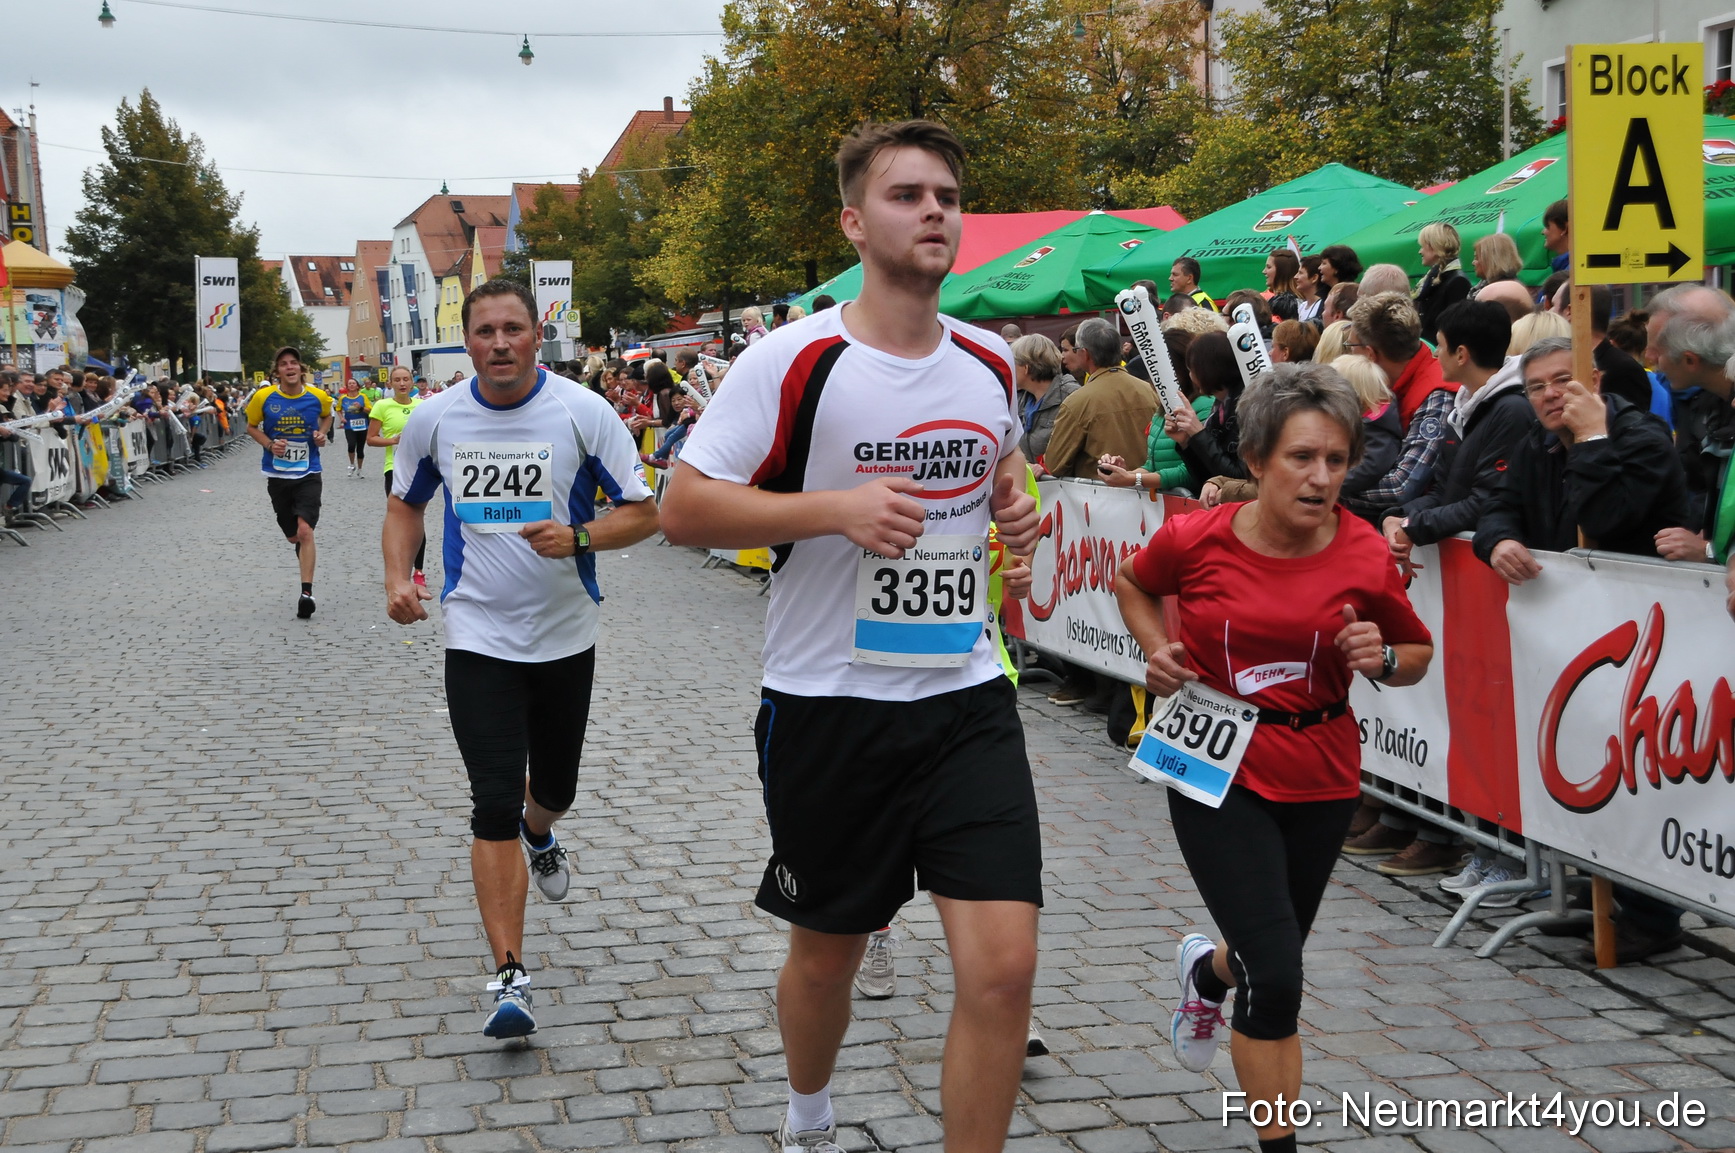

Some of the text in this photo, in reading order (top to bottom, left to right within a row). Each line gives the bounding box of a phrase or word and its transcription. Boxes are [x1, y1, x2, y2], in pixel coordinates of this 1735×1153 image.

[1589, 54, 1690, 96] Block
[1601, 117, 1677, 231] A
[1180, 243, 1317, 259] Lammsbru
[202, 275, 236, 287] swn
[538, 277, 571, 286] swn
[455, 451, 534, 460] PARTL Neumarkt
[854, 438, 989, 462] GERHART &
[462, 464, 543, 498] 2242
[855, 458, 988, 481] Autohaus JÄNIG
[484, 506, 521, 523] Ralph
[949, 491, 988, 519] Autohaus
[863, 549, 970, 562] PAL Neumarkt
[871, 566, 976, 618] 3359
[1066, 615, 1125, 655] Ostbayerns
[1254, 667, 1286, 684] DEHN
[1186, 689, 1237, 717] Neumarkt
[1153, 697, 1238, 761] 2590
[1375, 716, 1429, 768] Radio
[1155, 748, 1188, 777] Lydia
